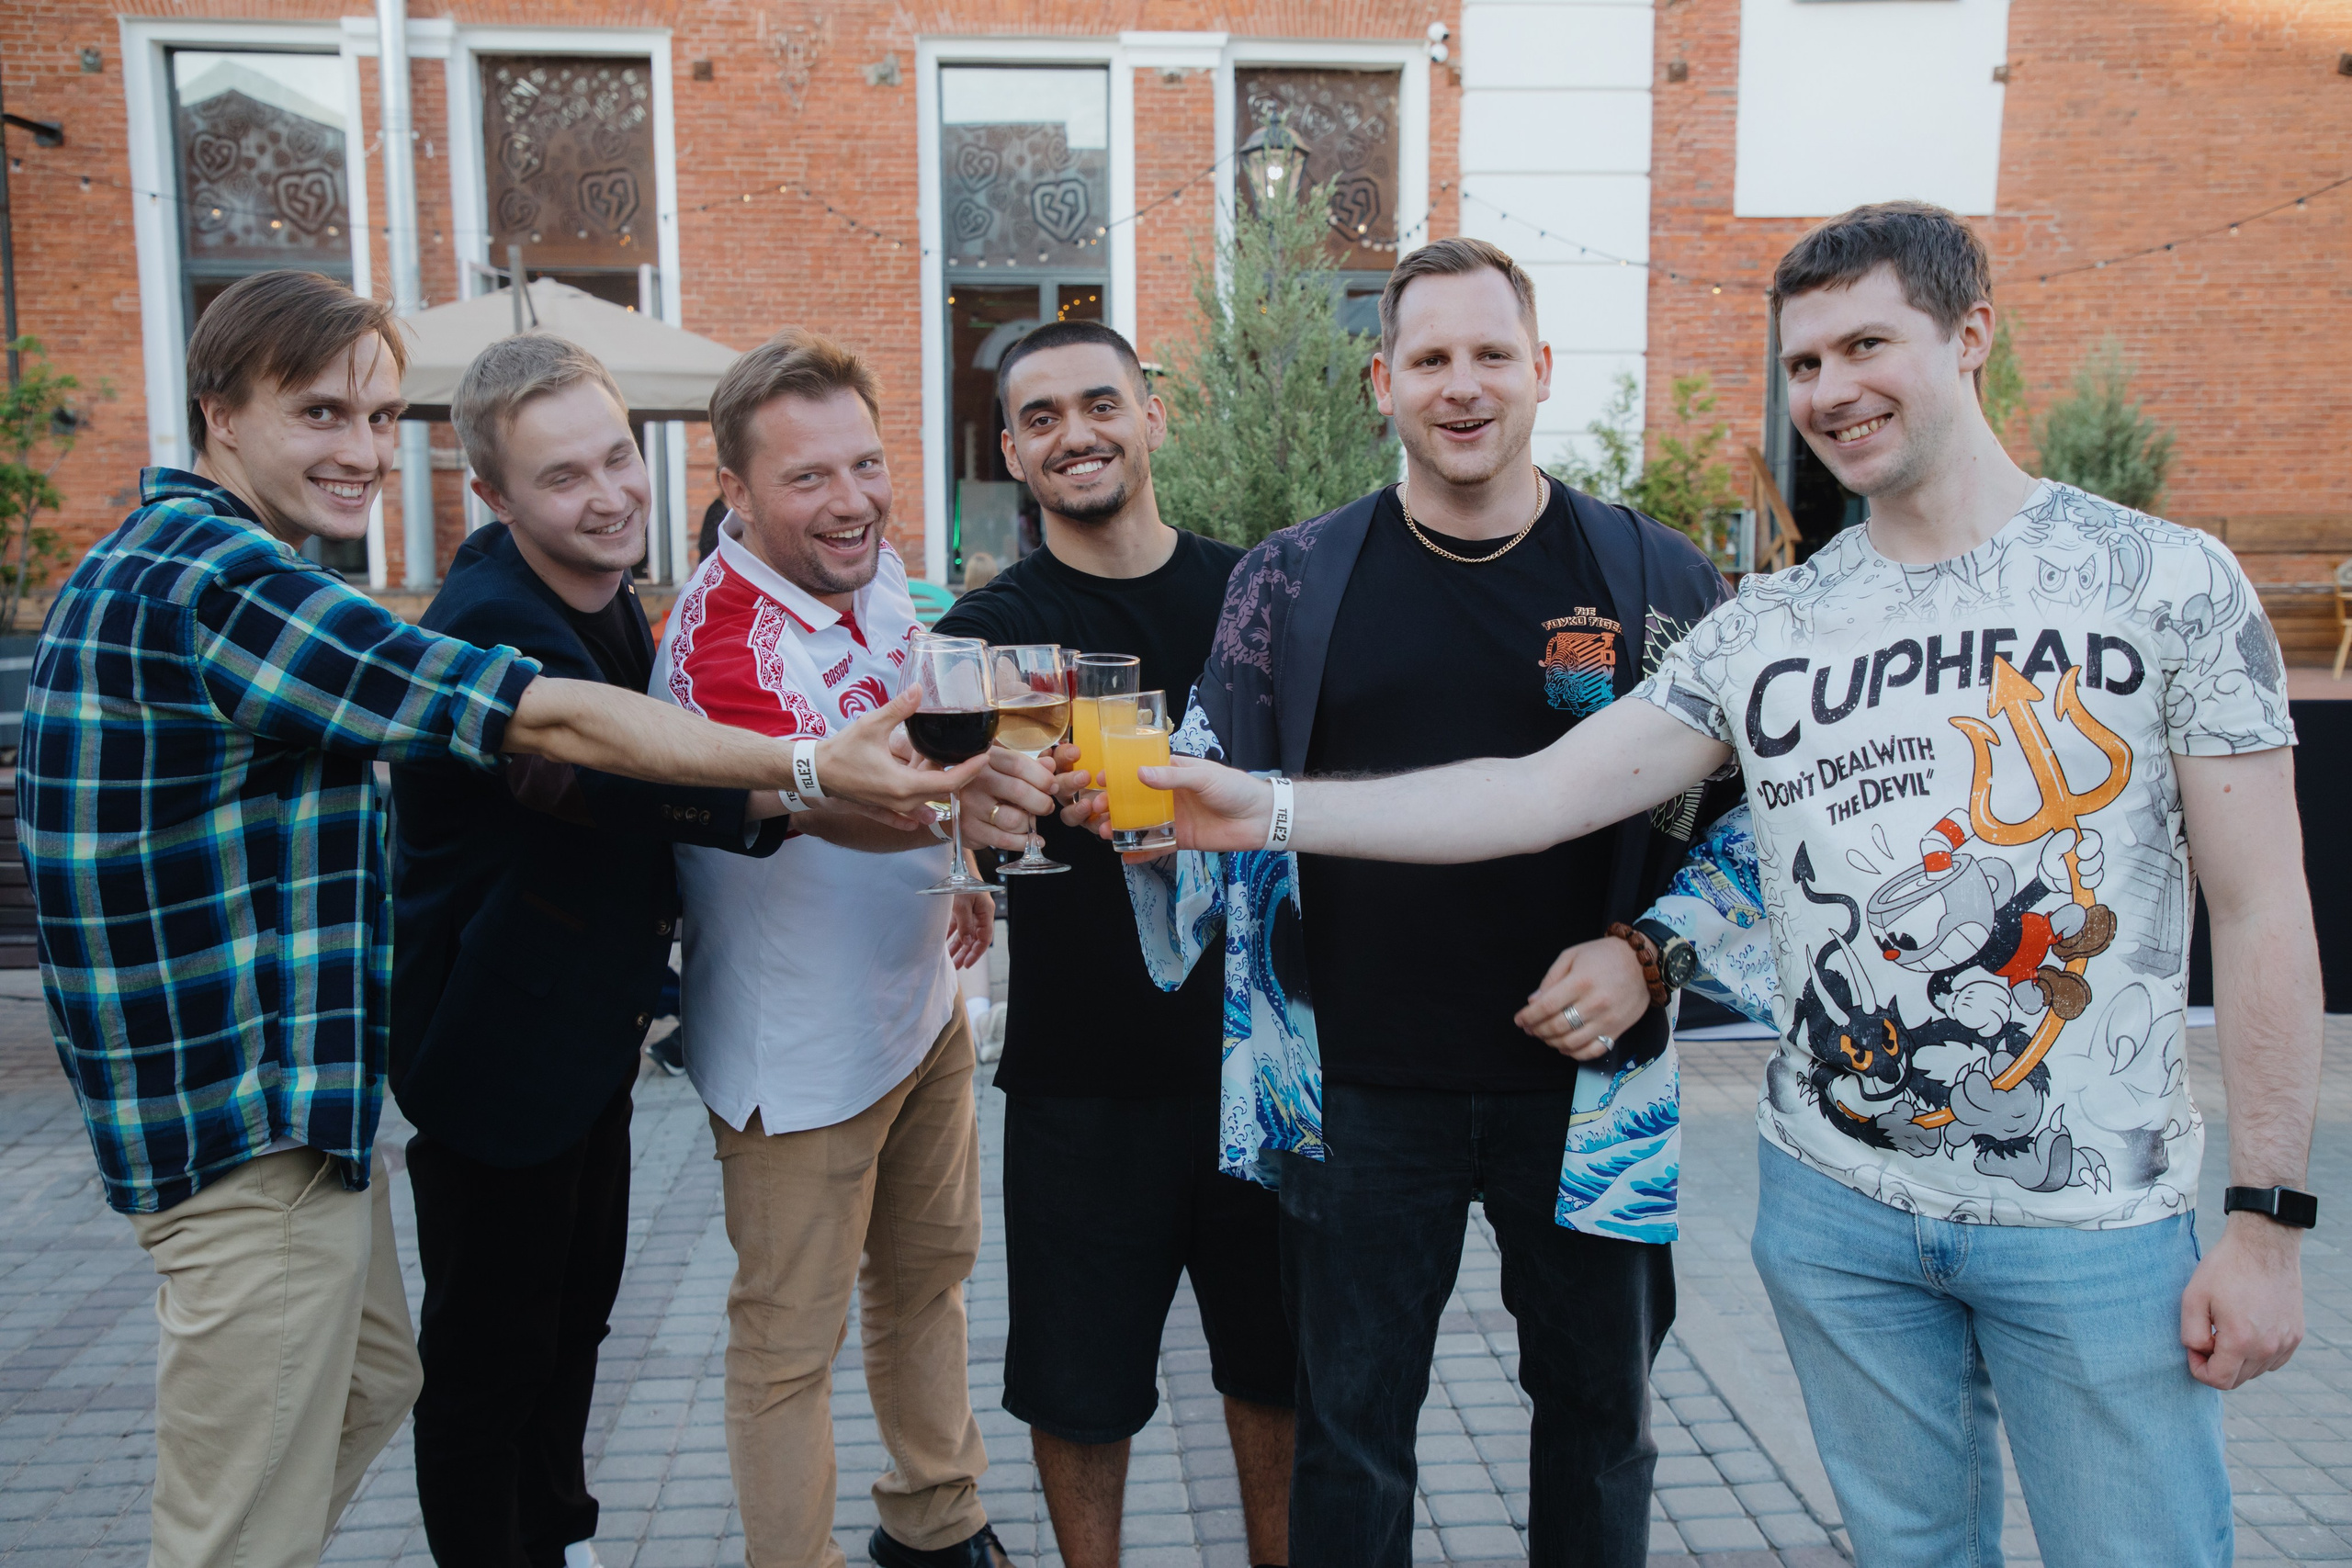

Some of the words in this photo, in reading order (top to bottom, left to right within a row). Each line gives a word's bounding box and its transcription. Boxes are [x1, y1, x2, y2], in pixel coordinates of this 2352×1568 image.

[1574, 607, 1597, 616] THE
[821, 657, 850, 689] BOSCO
[796, 758, 816, 789] TELE2
[1816, 746, 1877, 790] DEAL
[1869, 735, 1936, 767] WITH
[1272, 808, 1287, 841] TELE2
[1826, 794, 1861, 827] THE
